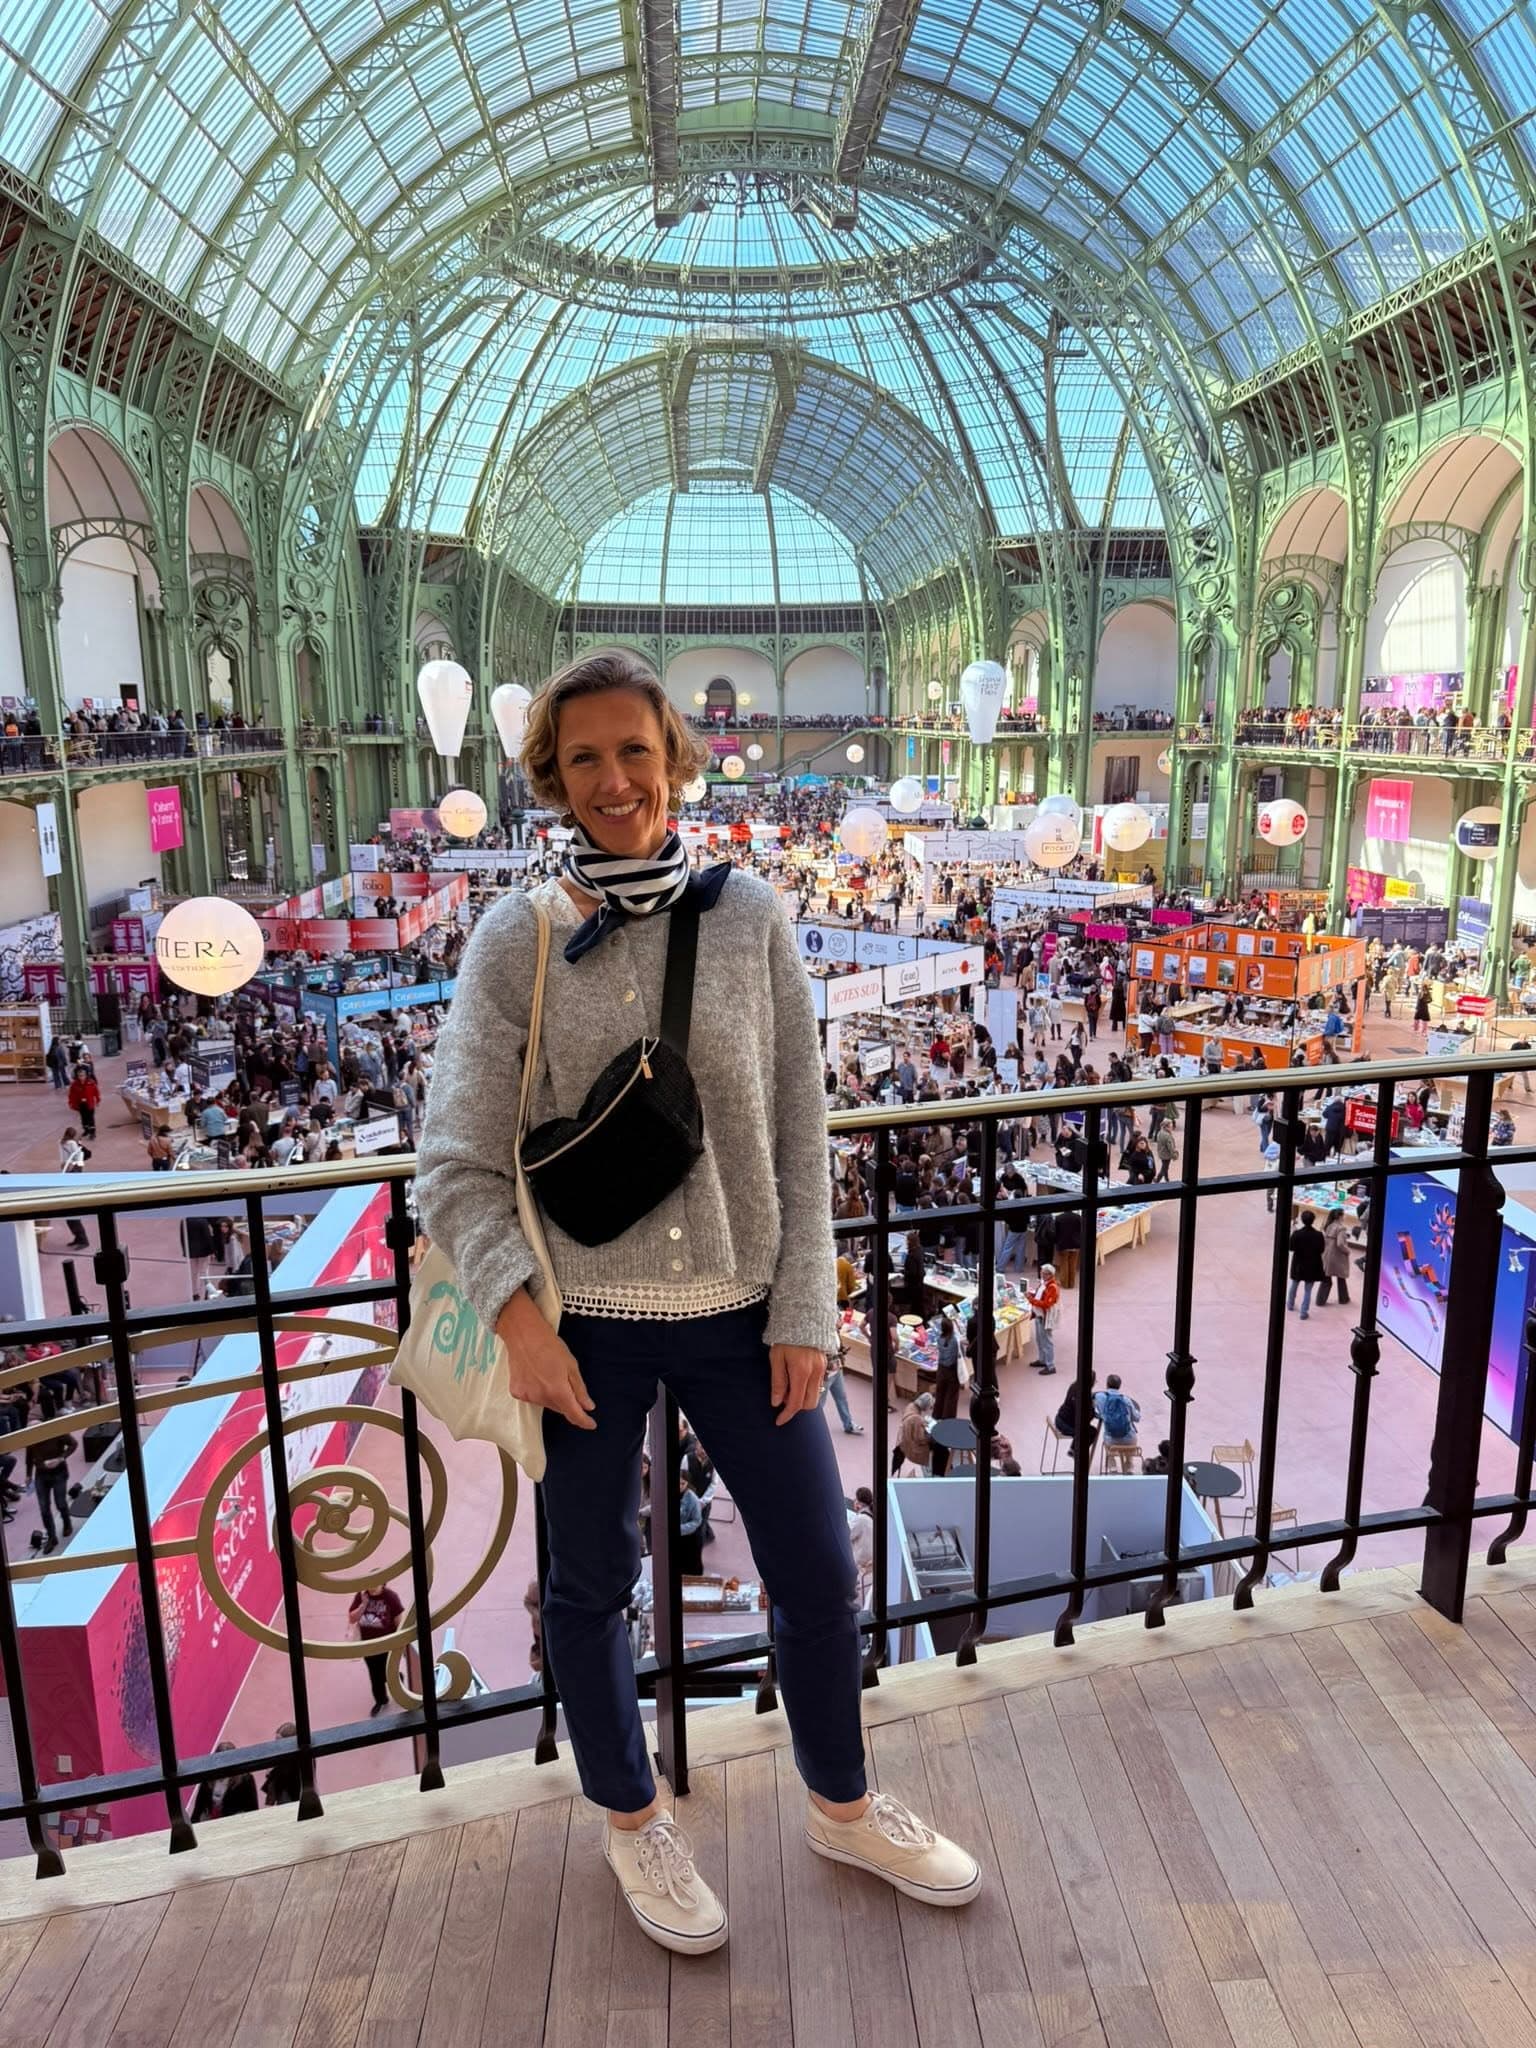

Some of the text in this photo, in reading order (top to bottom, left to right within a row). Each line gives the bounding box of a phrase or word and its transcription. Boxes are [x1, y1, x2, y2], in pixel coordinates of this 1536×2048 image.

[362, 878, 384, 892] folio
[831, 981, 880, 1004] ACTES SUD
